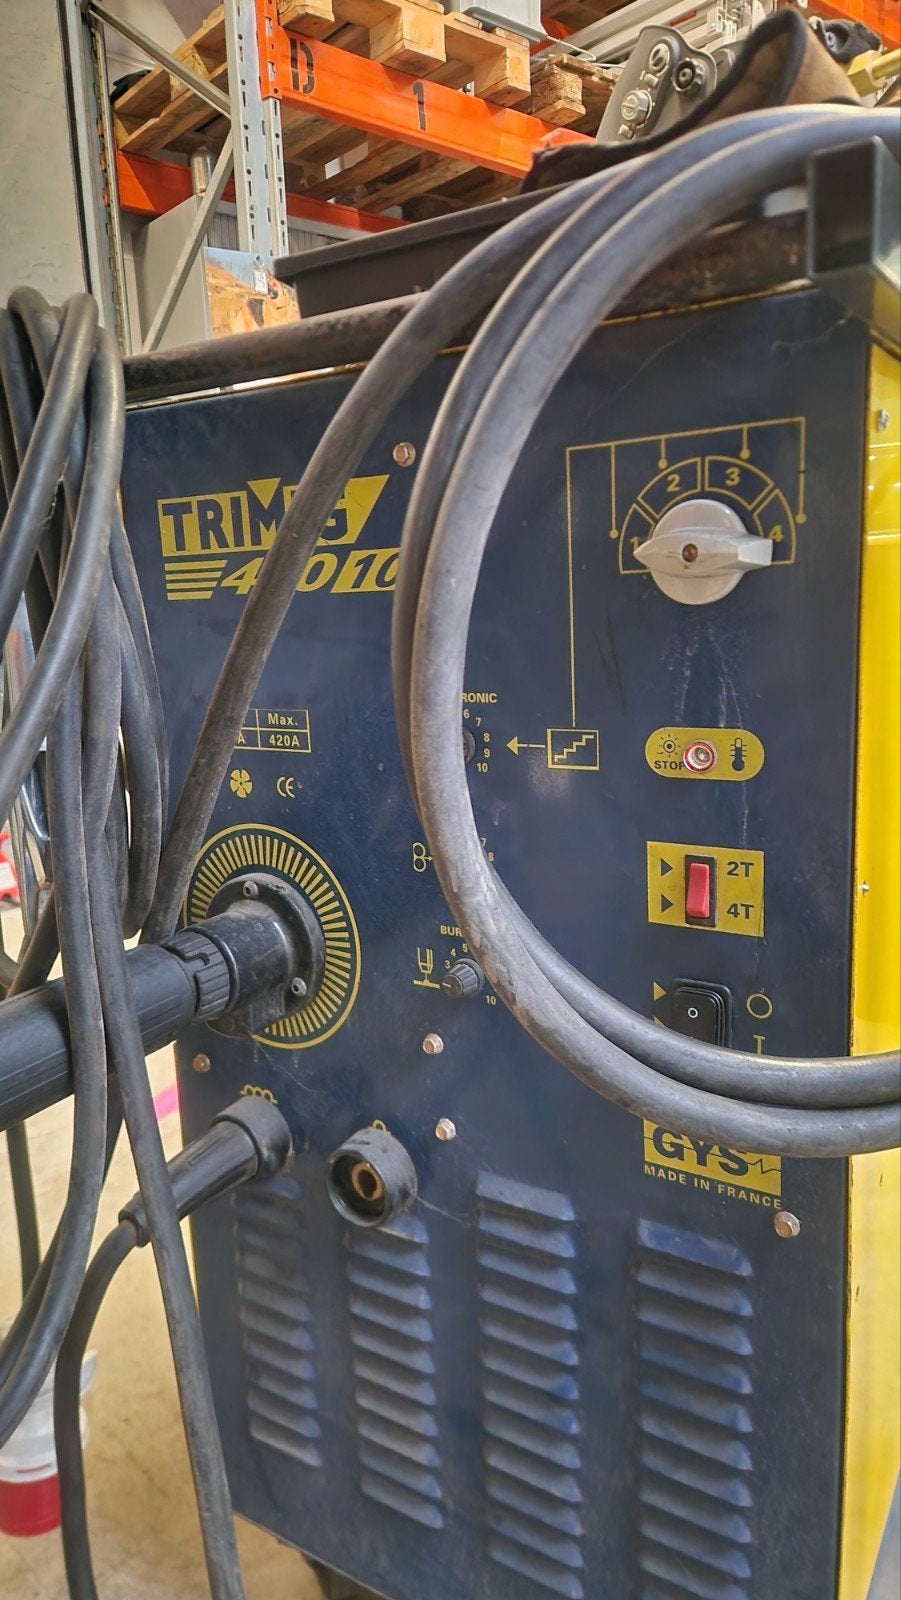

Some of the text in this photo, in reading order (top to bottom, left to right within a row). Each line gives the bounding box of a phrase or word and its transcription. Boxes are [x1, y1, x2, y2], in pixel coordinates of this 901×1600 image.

[290, 38, 426, 131] D 1
[666, 474, 681, 492] 2
[725, 467, 741, 486] 3
[162, 486, 348, 551] TRIMG
[768, 525, 784, 542] 4
[220, 551, 339, 594] 40
[267, 713, 298, 726] Max.
[463, 709, 470, 719] 6
[475, 717, 482, 727] 7
[269, 734, 300, 747] 420A
[483, 732, 490, 743] 8
[483, 748, 490, 758] 9
[476, 762, 488, 772] 10
[726, 860, 754, 878] 2T
[726, 902, 754, 920] 4T
[450, 948, 457, 958] 4
[462, 943, 469, 953] 5
[444, 960, 451, 969] 3
[485, 995, 497, 1006] 10
[652, 1126, 749, 1177] GYS
[644, 1164, 782, 1210] MADE IN FRANCE
